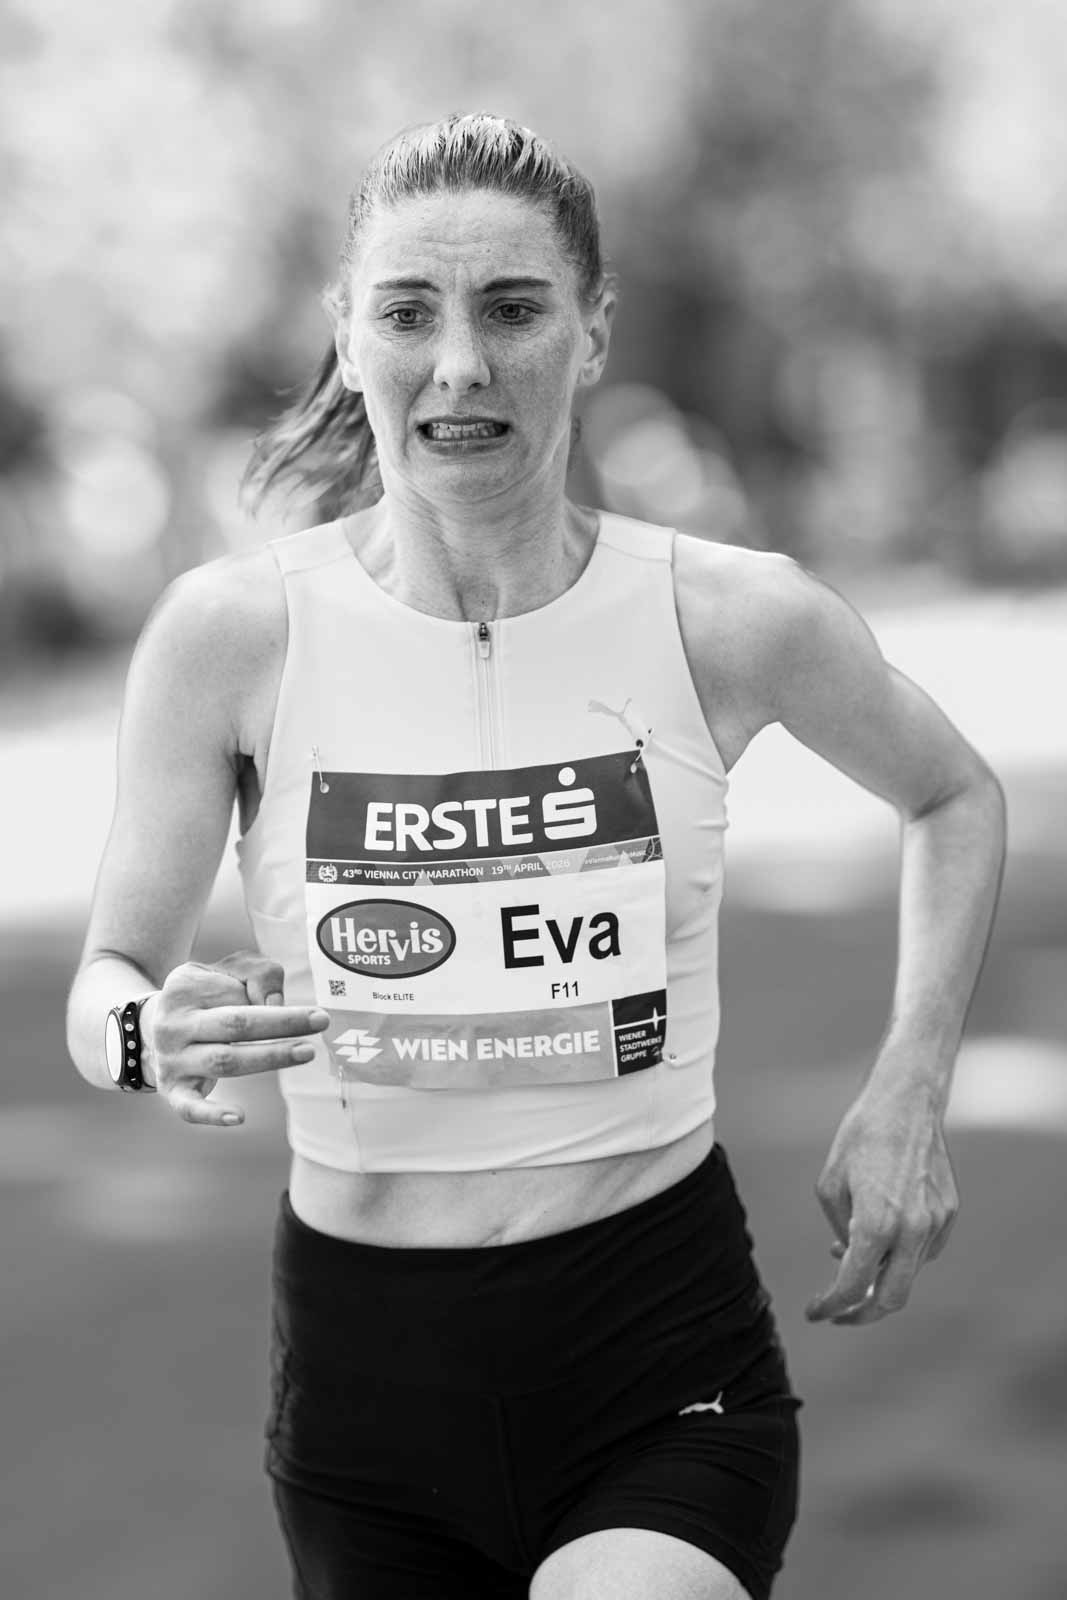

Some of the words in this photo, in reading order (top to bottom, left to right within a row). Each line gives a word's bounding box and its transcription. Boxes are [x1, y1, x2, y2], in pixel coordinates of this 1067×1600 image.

[364, 795, 533, 852] ERSTE
[364, 869, 400, 880] VIENNA
[402, 870, 423, 880] CITY
[427, 867, 484, 879] MARATHON
[514, 861, 544, 873] APRIL
[329, 917, 444, 962] Hervis
[500, 904, 621, 969] Eva
[347, 954, 391, 966] SPORTS
[372, 991, 392, 1001] Block
[393, 992, 415, 1001] ELITE
[550, 981, 579, 999] F11
[619, 1030, 647, 1042] WIENER
[391, 1037, 470, 1061] WIEN
[477, 1030, 601, 1060] ENERGIE
[620, 1050, 648, 1063] GRUPPE
